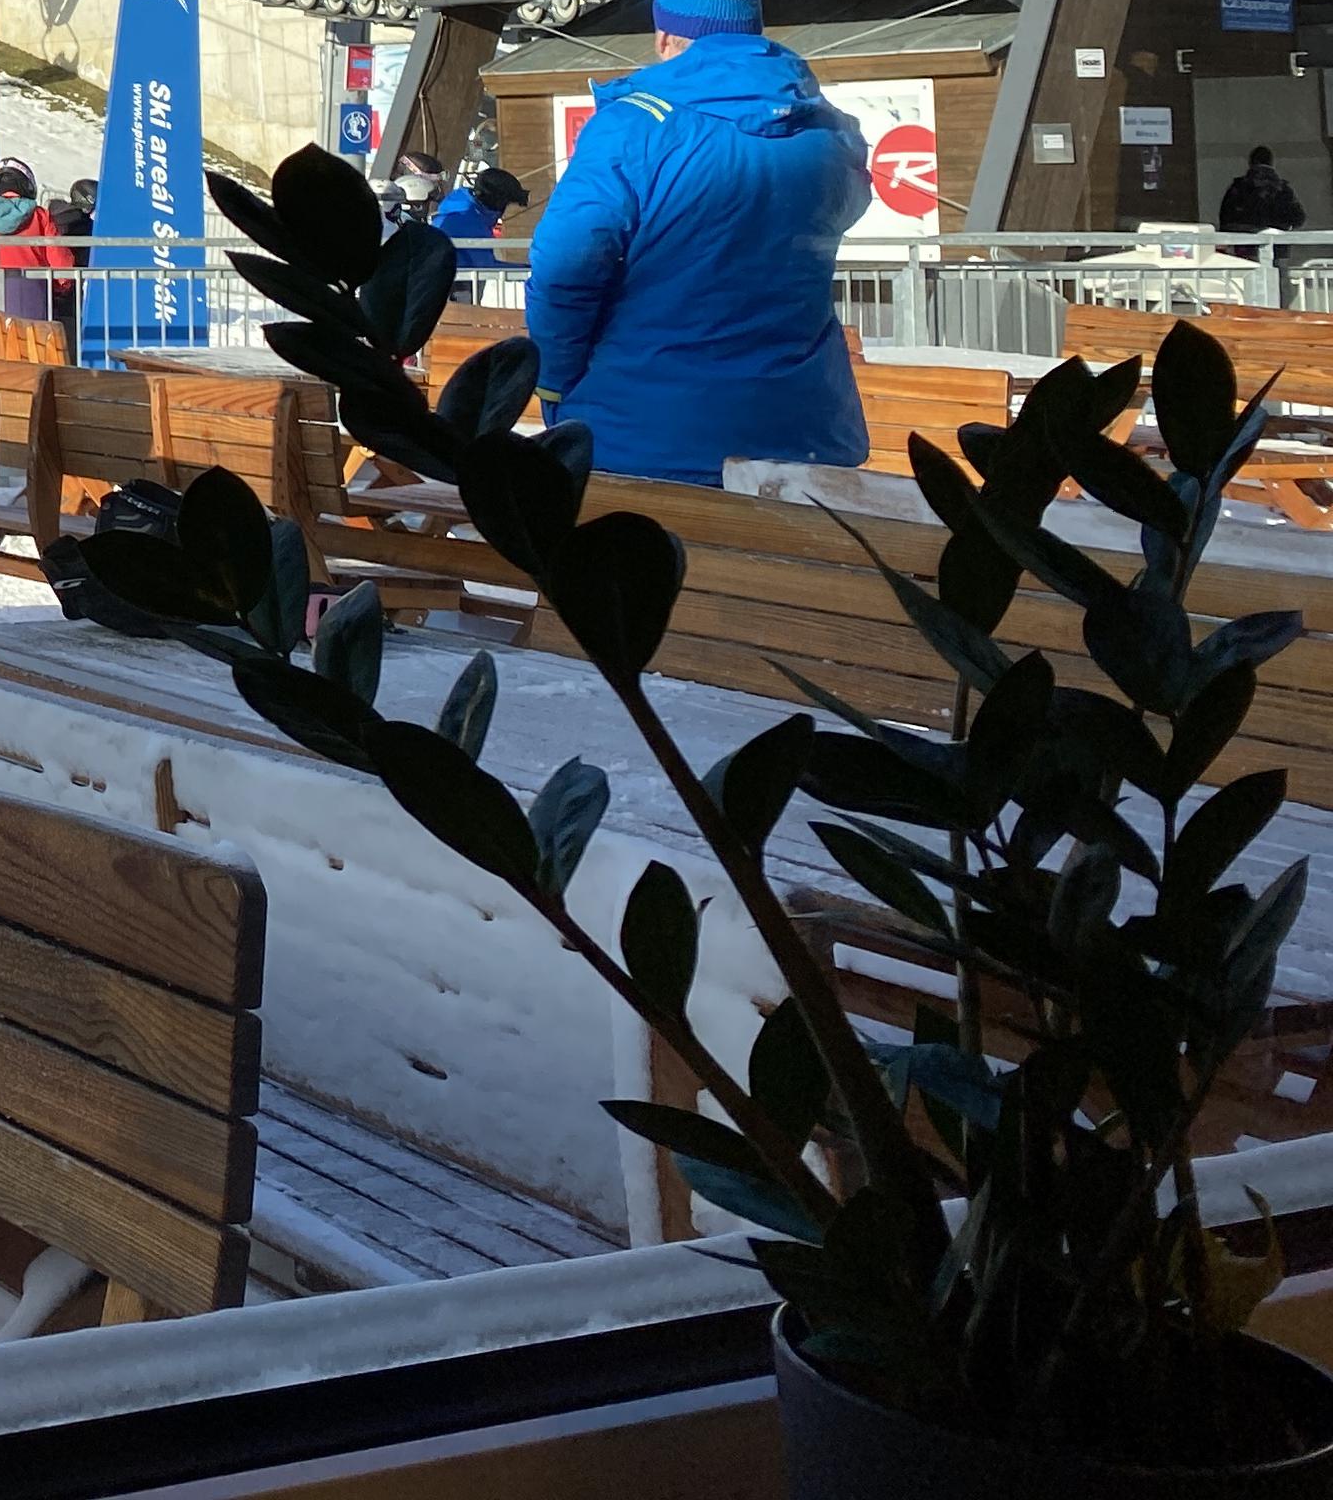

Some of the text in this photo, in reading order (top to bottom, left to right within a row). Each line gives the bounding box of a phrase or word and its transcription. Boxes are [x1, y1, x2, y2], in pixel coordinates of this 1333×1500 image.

[132, 83, 146, 189] www.spicak.cz
[149, 80, 172, 130] Ski
[150, 135, 175, 215] areál
